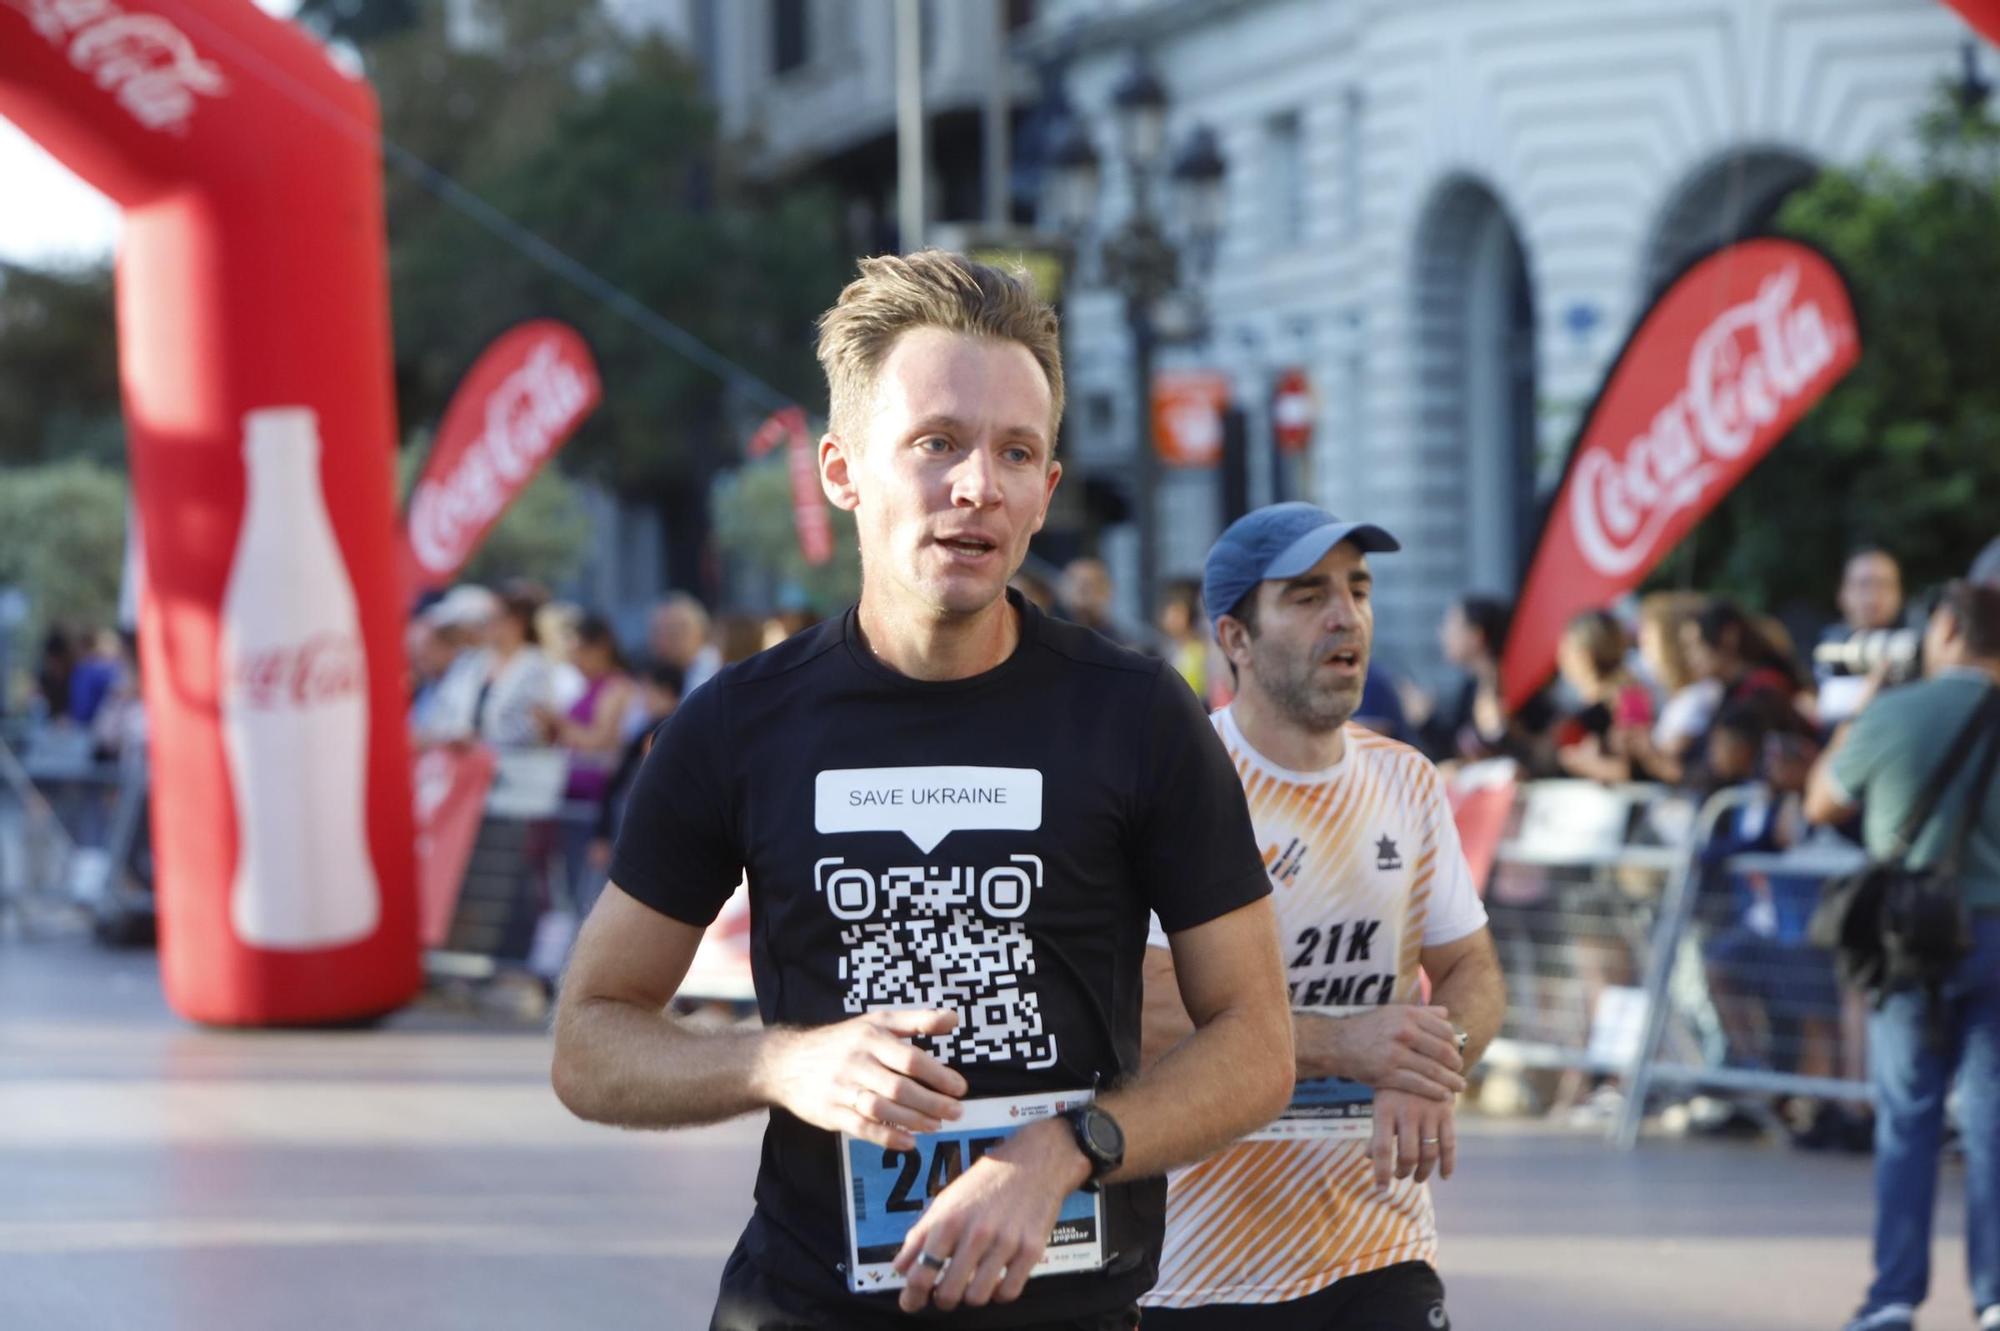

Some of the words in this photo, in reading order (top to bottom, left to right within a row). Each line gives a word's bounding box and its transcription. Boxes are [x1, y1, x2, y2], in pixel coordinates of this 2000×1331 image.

[848, 789, 904, 807] SAVE
[911, 787, 1008, 805] UKRAINE
[1290, 919, 1381, 969] 21K
[1053, 1230, 1089, 1243] popular
